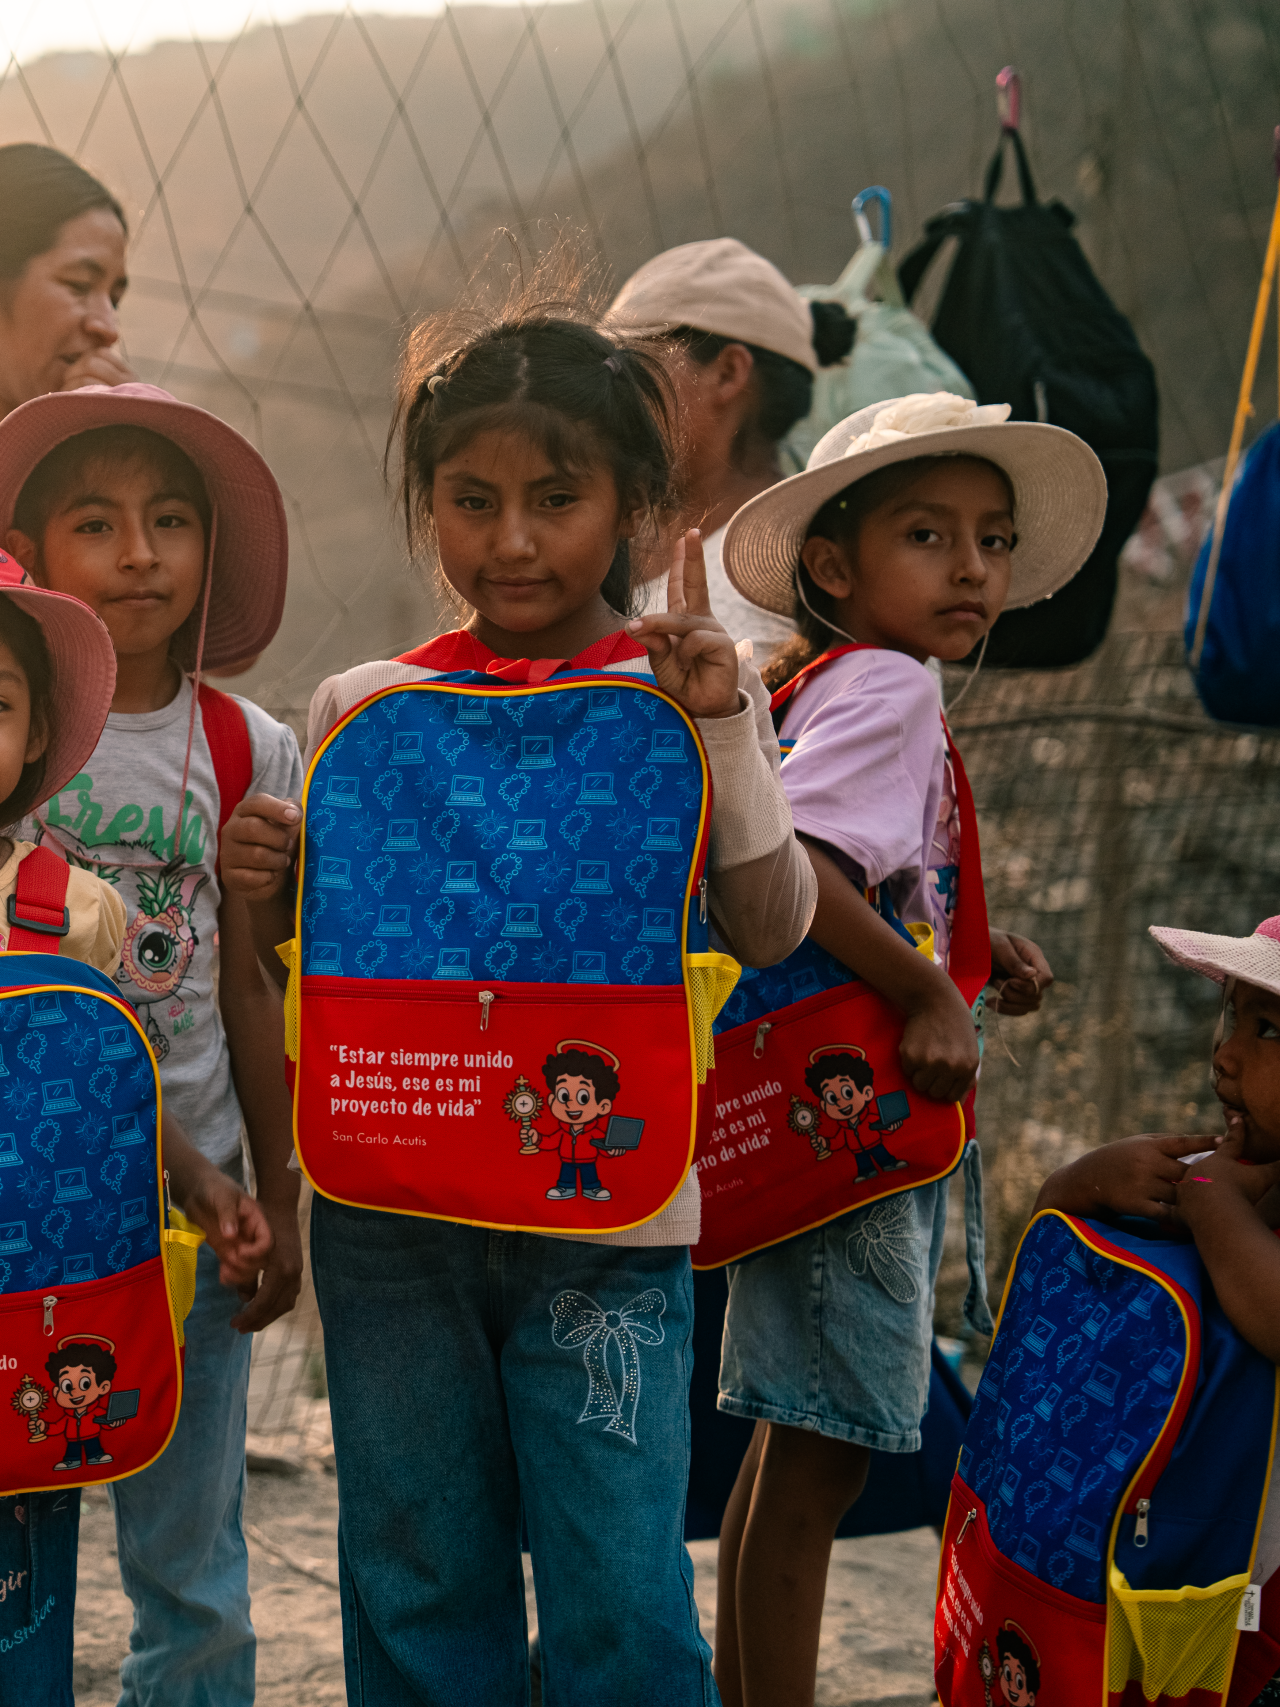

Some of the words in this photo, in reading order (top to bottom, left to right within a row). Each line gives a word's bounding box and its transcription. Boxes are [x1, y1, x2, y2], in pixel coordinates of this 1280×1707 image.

[390, 1048, 459, 1071] siempre
[464, 1050, 514, 1069] unido
[330, 1072, 340, 1088] a
[345, 1070, 398, 1093] Jesús,
[402, 1076, 430, 1092] ese
[435, 1076, 454, 1092] es
[458, 1075, 481, 1093] mi
[742, 1080, 782, 1106] unido
[330, 1097, 408, 1117] proyecto
[412, 1097, 432, 1117] de
[712, 1127, 726, 1142] se
[729, 1119, 746, 1135] es
[746, 1108, 767, 1128] mi
[332, 1130, 353, 1143] San
[357, 1131, 389, 1146] Carlo
[393, 1133, 427, 1147] Acutis
[720, 1145, 736, 1162] de
